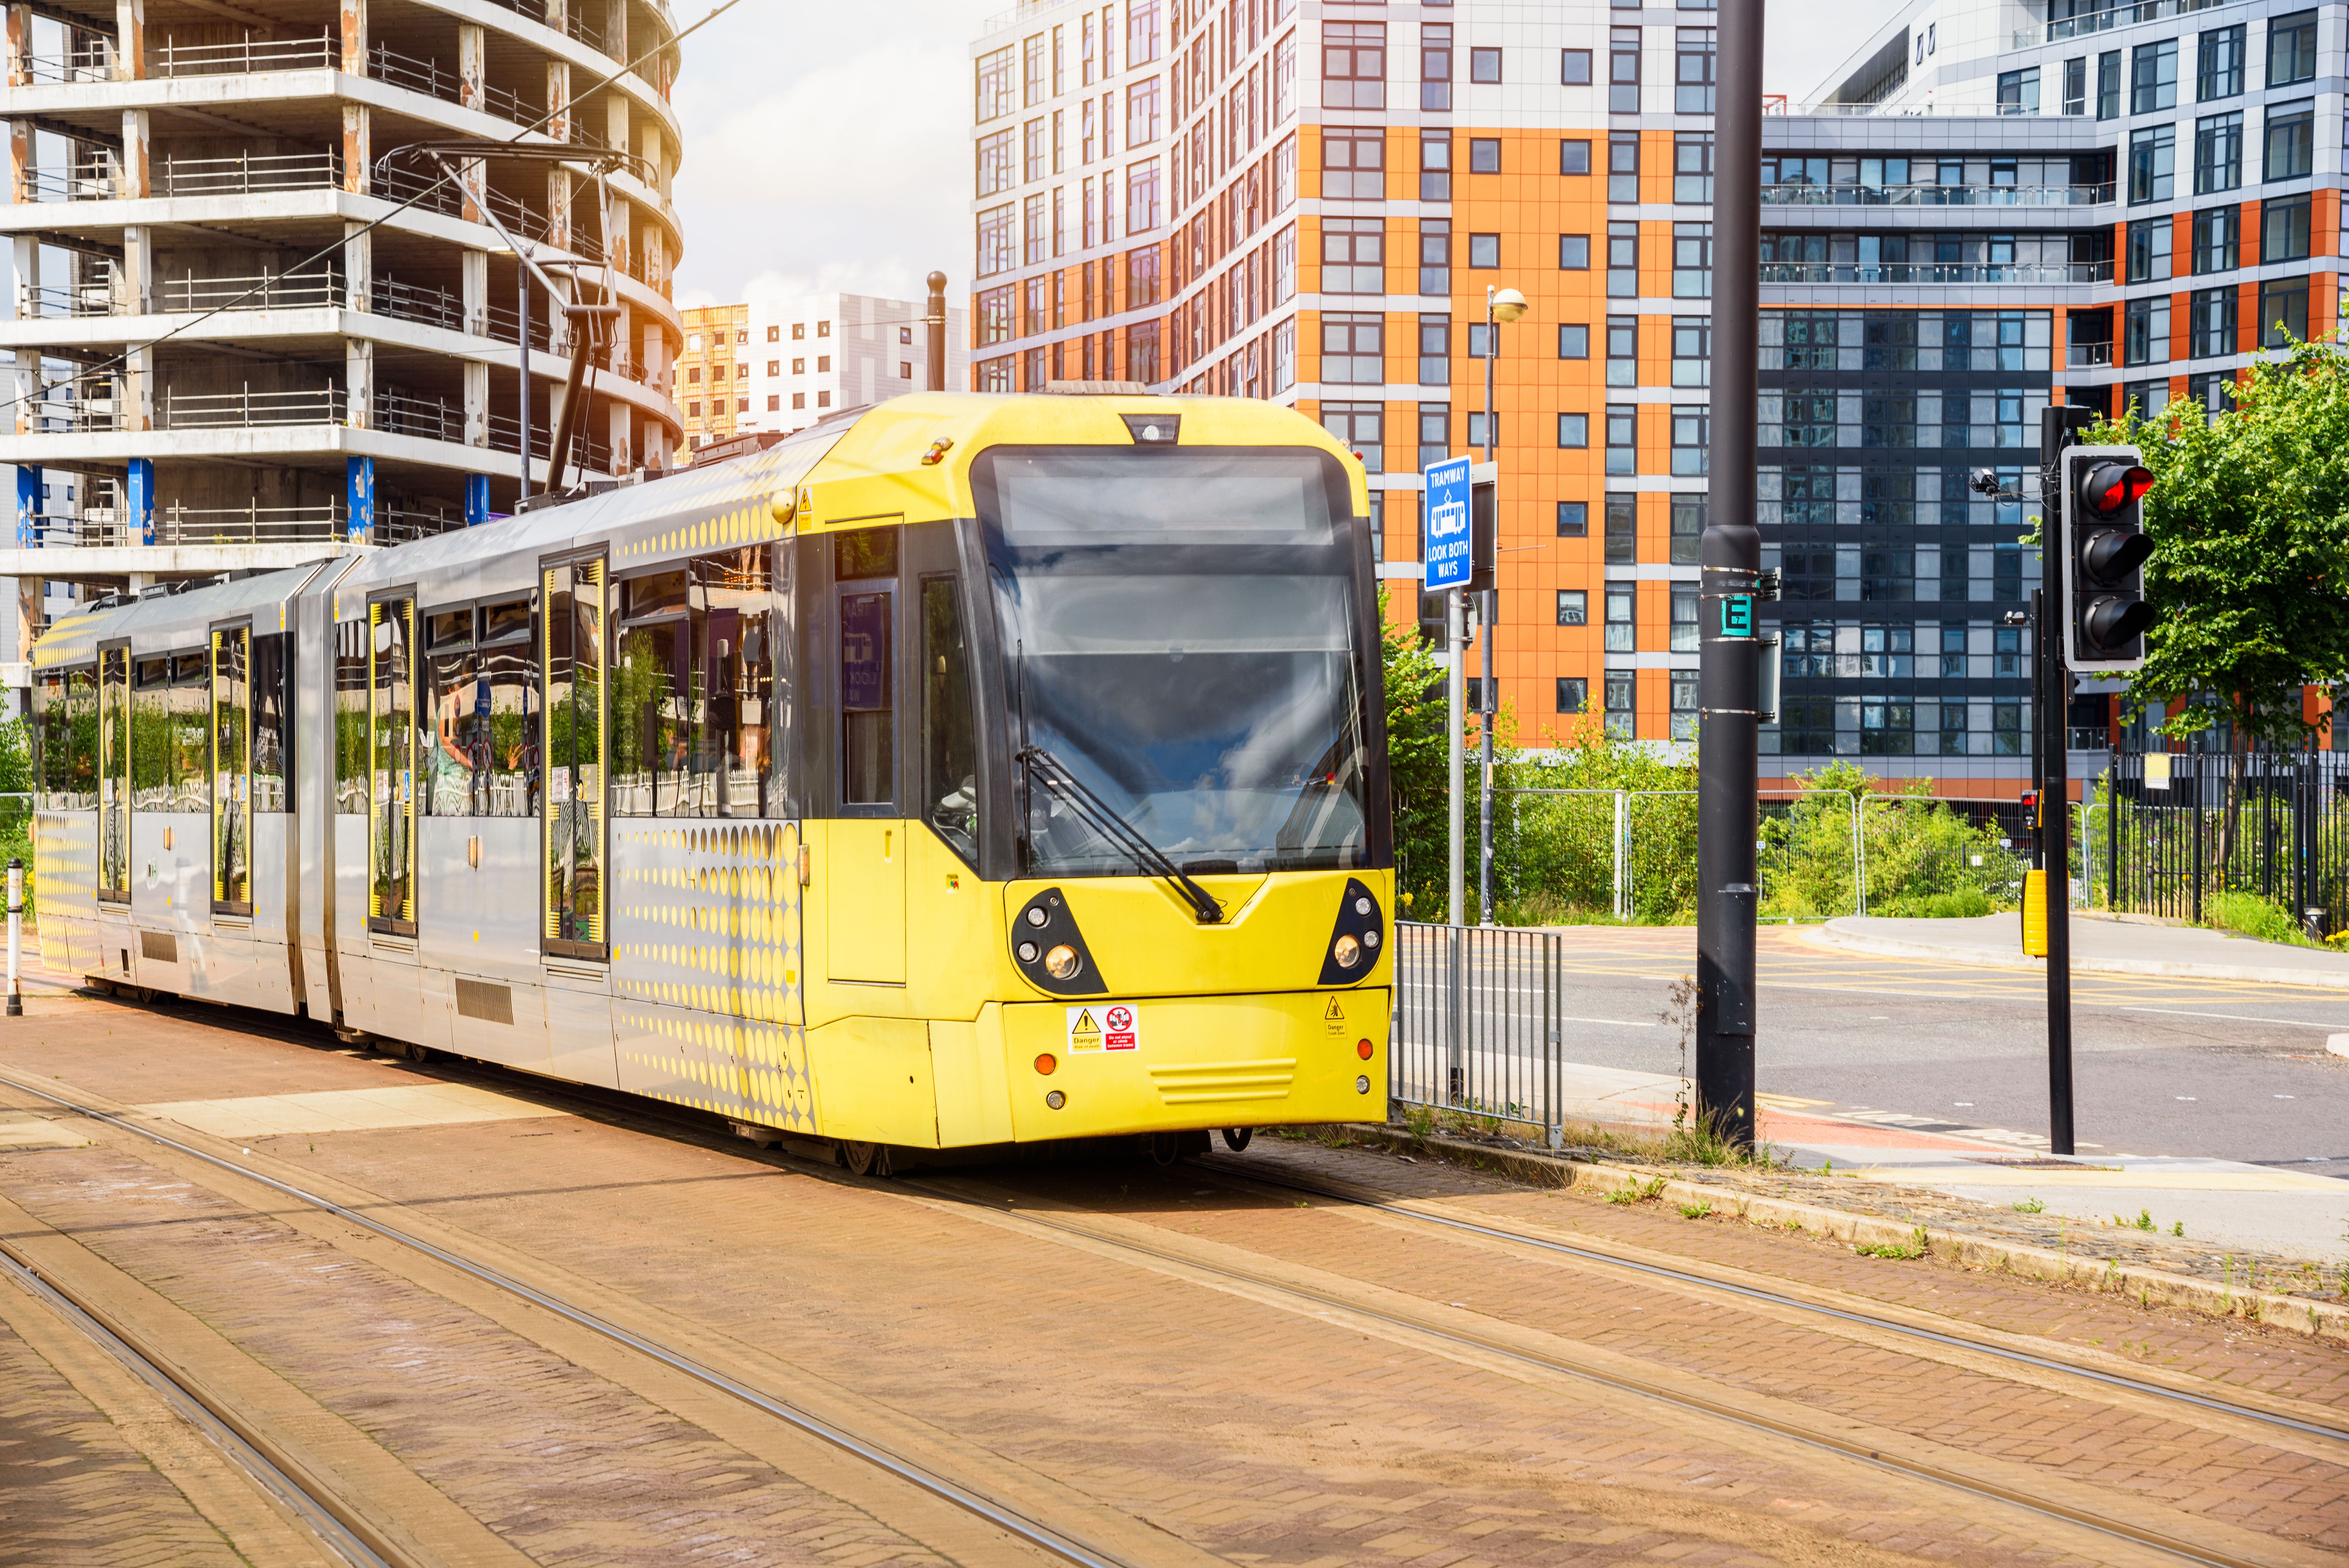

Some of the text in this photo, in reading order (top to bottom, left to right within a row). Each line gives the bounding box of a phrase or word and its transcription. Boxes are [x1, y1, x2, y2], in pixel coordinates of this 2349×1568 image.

[1431, 465, 1465, 488] TRAMWAY
[1428, 540, 1468, 562] LOOK BOTH
[1438, 561, 1458, 578] WAYS
[1726, 600, 1747, 629] E
